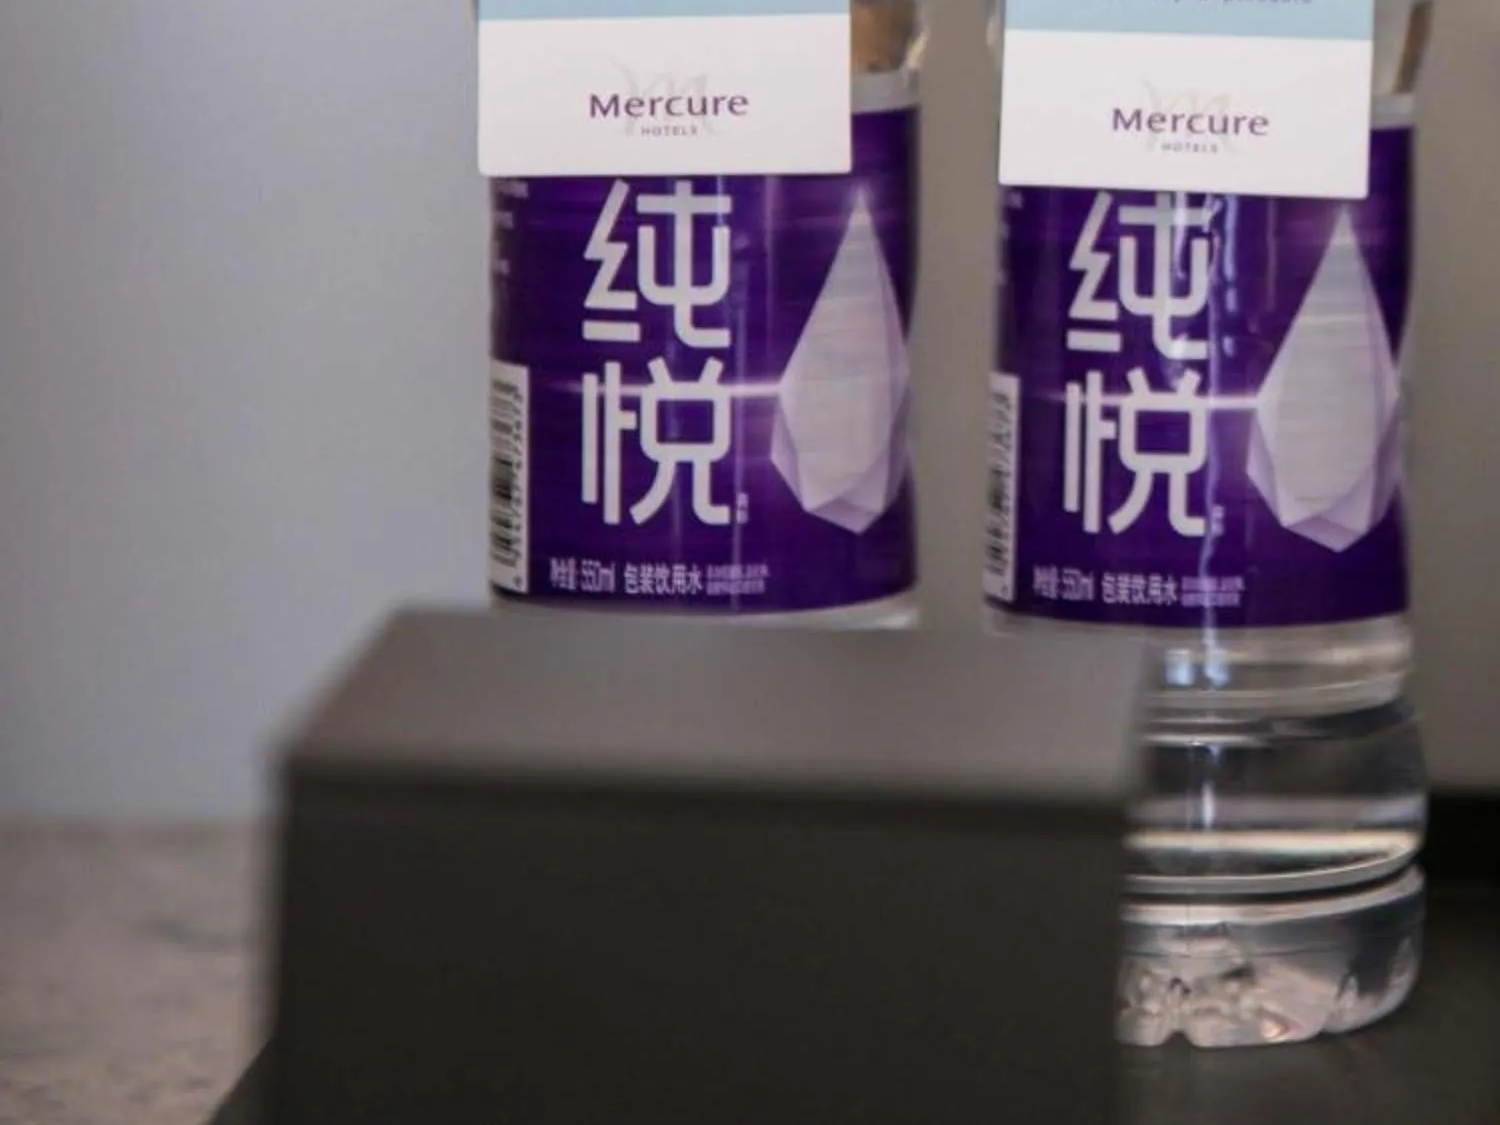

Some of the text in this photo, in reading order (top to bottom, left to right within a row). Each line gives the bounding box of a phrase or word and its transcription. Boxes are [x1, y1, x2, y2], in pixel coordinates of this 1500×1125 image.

[589, 92, 749, 119] Mercure
[1112, 107, 1269, 136] Mercure
[581, 178, 732, 526] 纯悦
[1063, 191, 1210, 537] 纯悦
[624, 561, 703, 596] 包装饮用水
